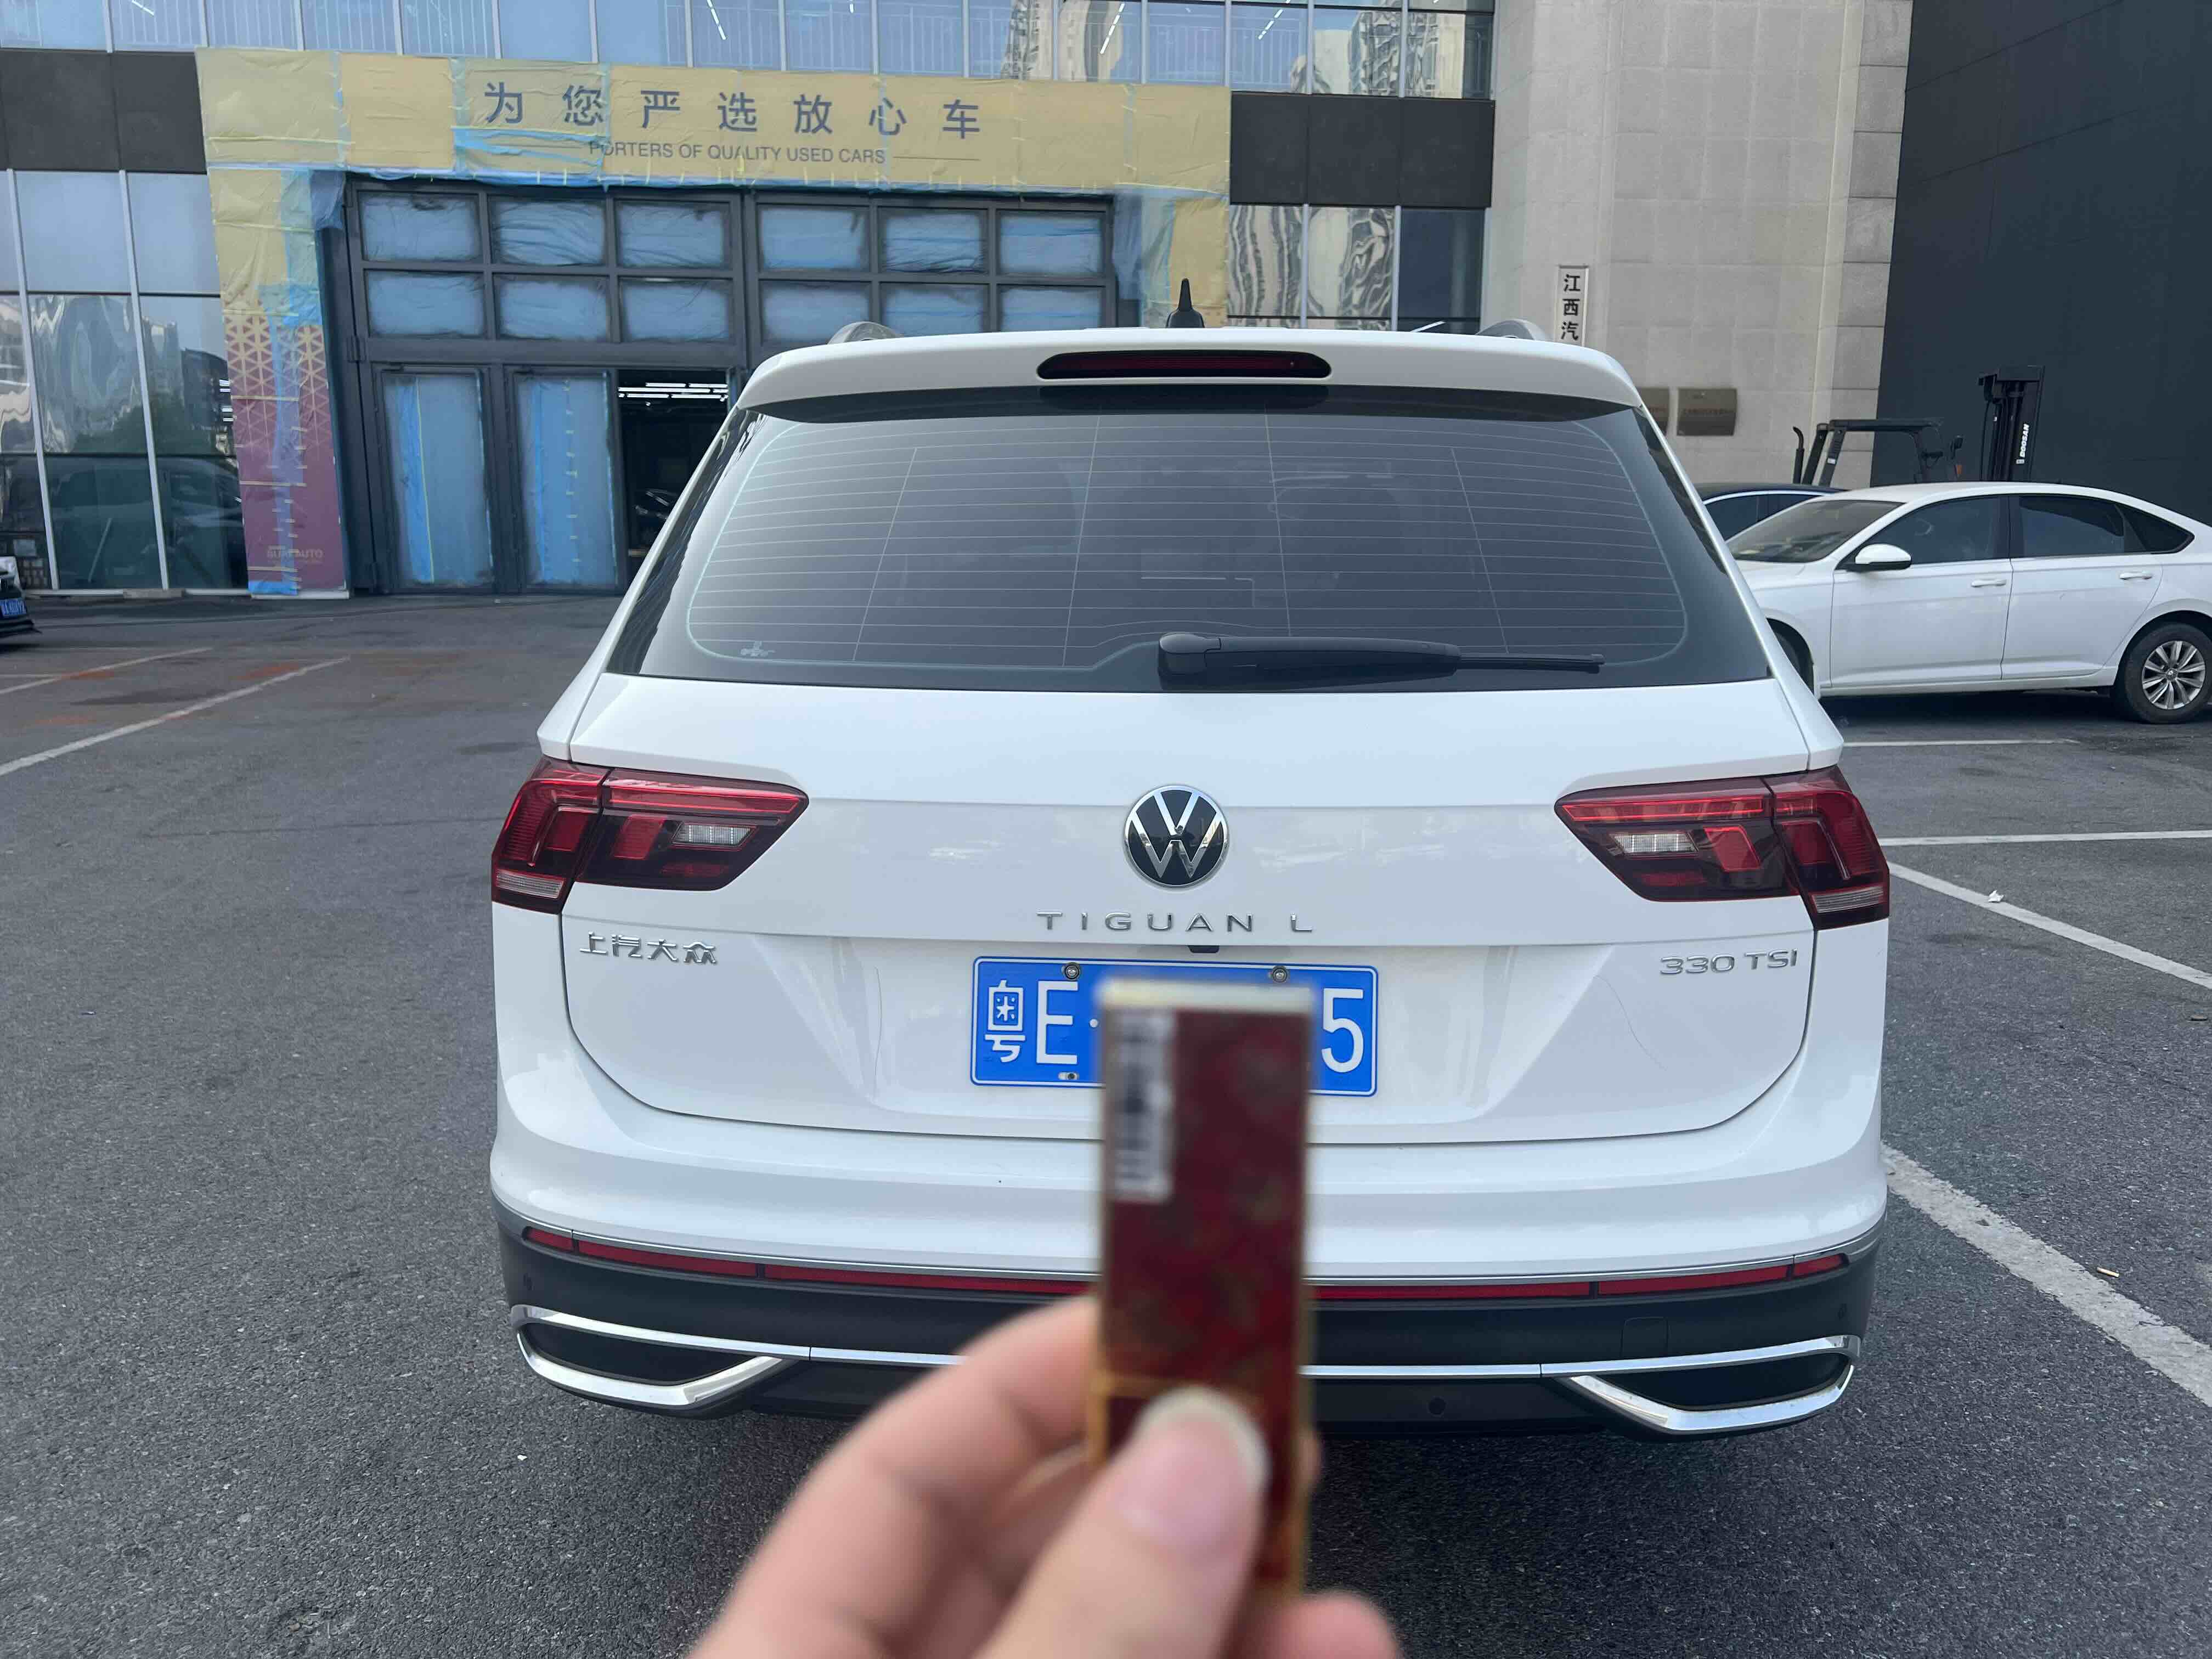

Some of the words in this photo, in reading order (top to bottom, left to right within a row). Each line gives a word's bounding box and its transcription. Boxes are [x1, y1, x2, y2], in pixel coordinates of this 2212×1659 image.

[484, 81, 981, 139] 为您严选放心车
[678, 144, 703, 159] OF
[707, 144, 781, 161] QUALITY
[786, 147, 834, 162] USED
[838, 148, 885, 164] CARS
[1561, 273, 1581, 341] 江西汽
[2019, 423, 2029, 458] DOOSAN
[1036, 911, 1254, 932] TIGUAN
[1290, 913, 1313, 932] L
[579, 931, 716, 964] 上汽大众
[1660, 953, 1735, 975] 330
[1744, 948, 1798, 970] TSI
